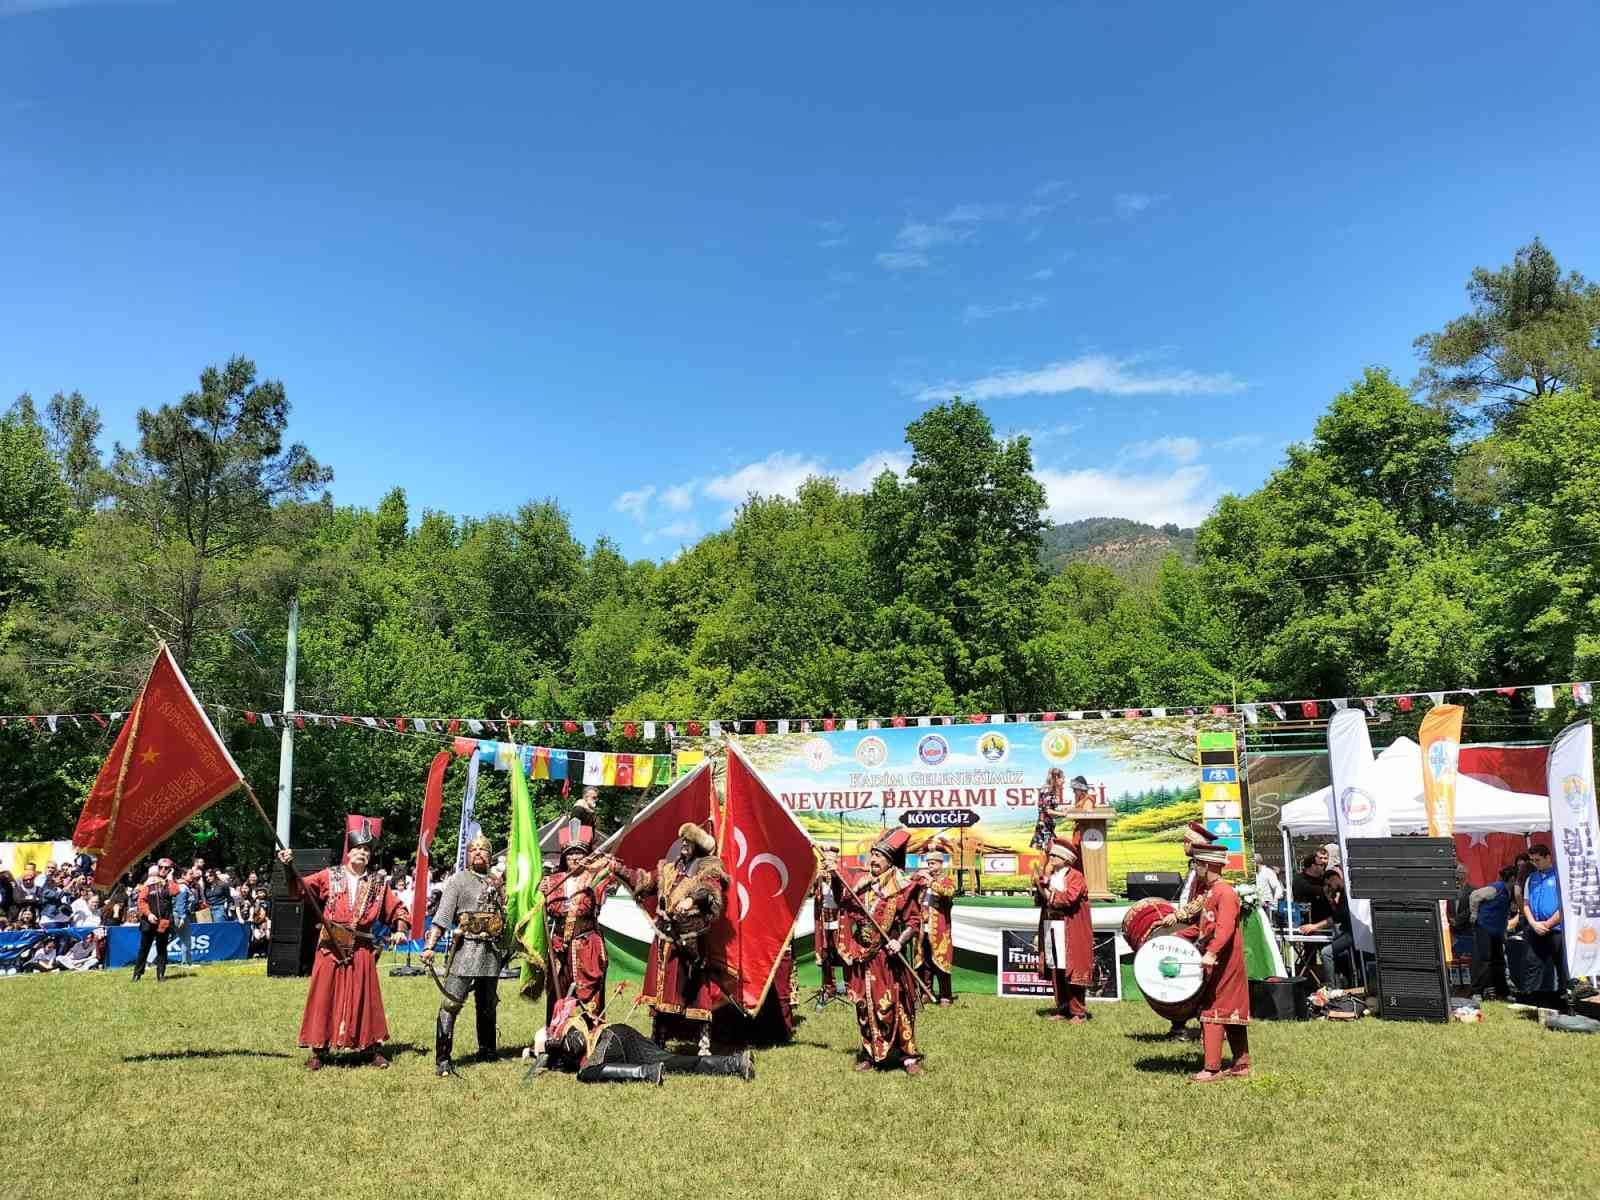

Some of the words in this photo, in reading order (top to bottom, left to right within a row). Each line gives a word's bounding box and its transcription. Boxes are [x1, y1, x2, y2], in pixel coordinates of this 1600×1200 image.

[781, 791, 872, 809] NEVRUZ
[880, 788, 997, 808] BAYRAMI
[908, 811, 970, 824] KÖYCEĞİZ
